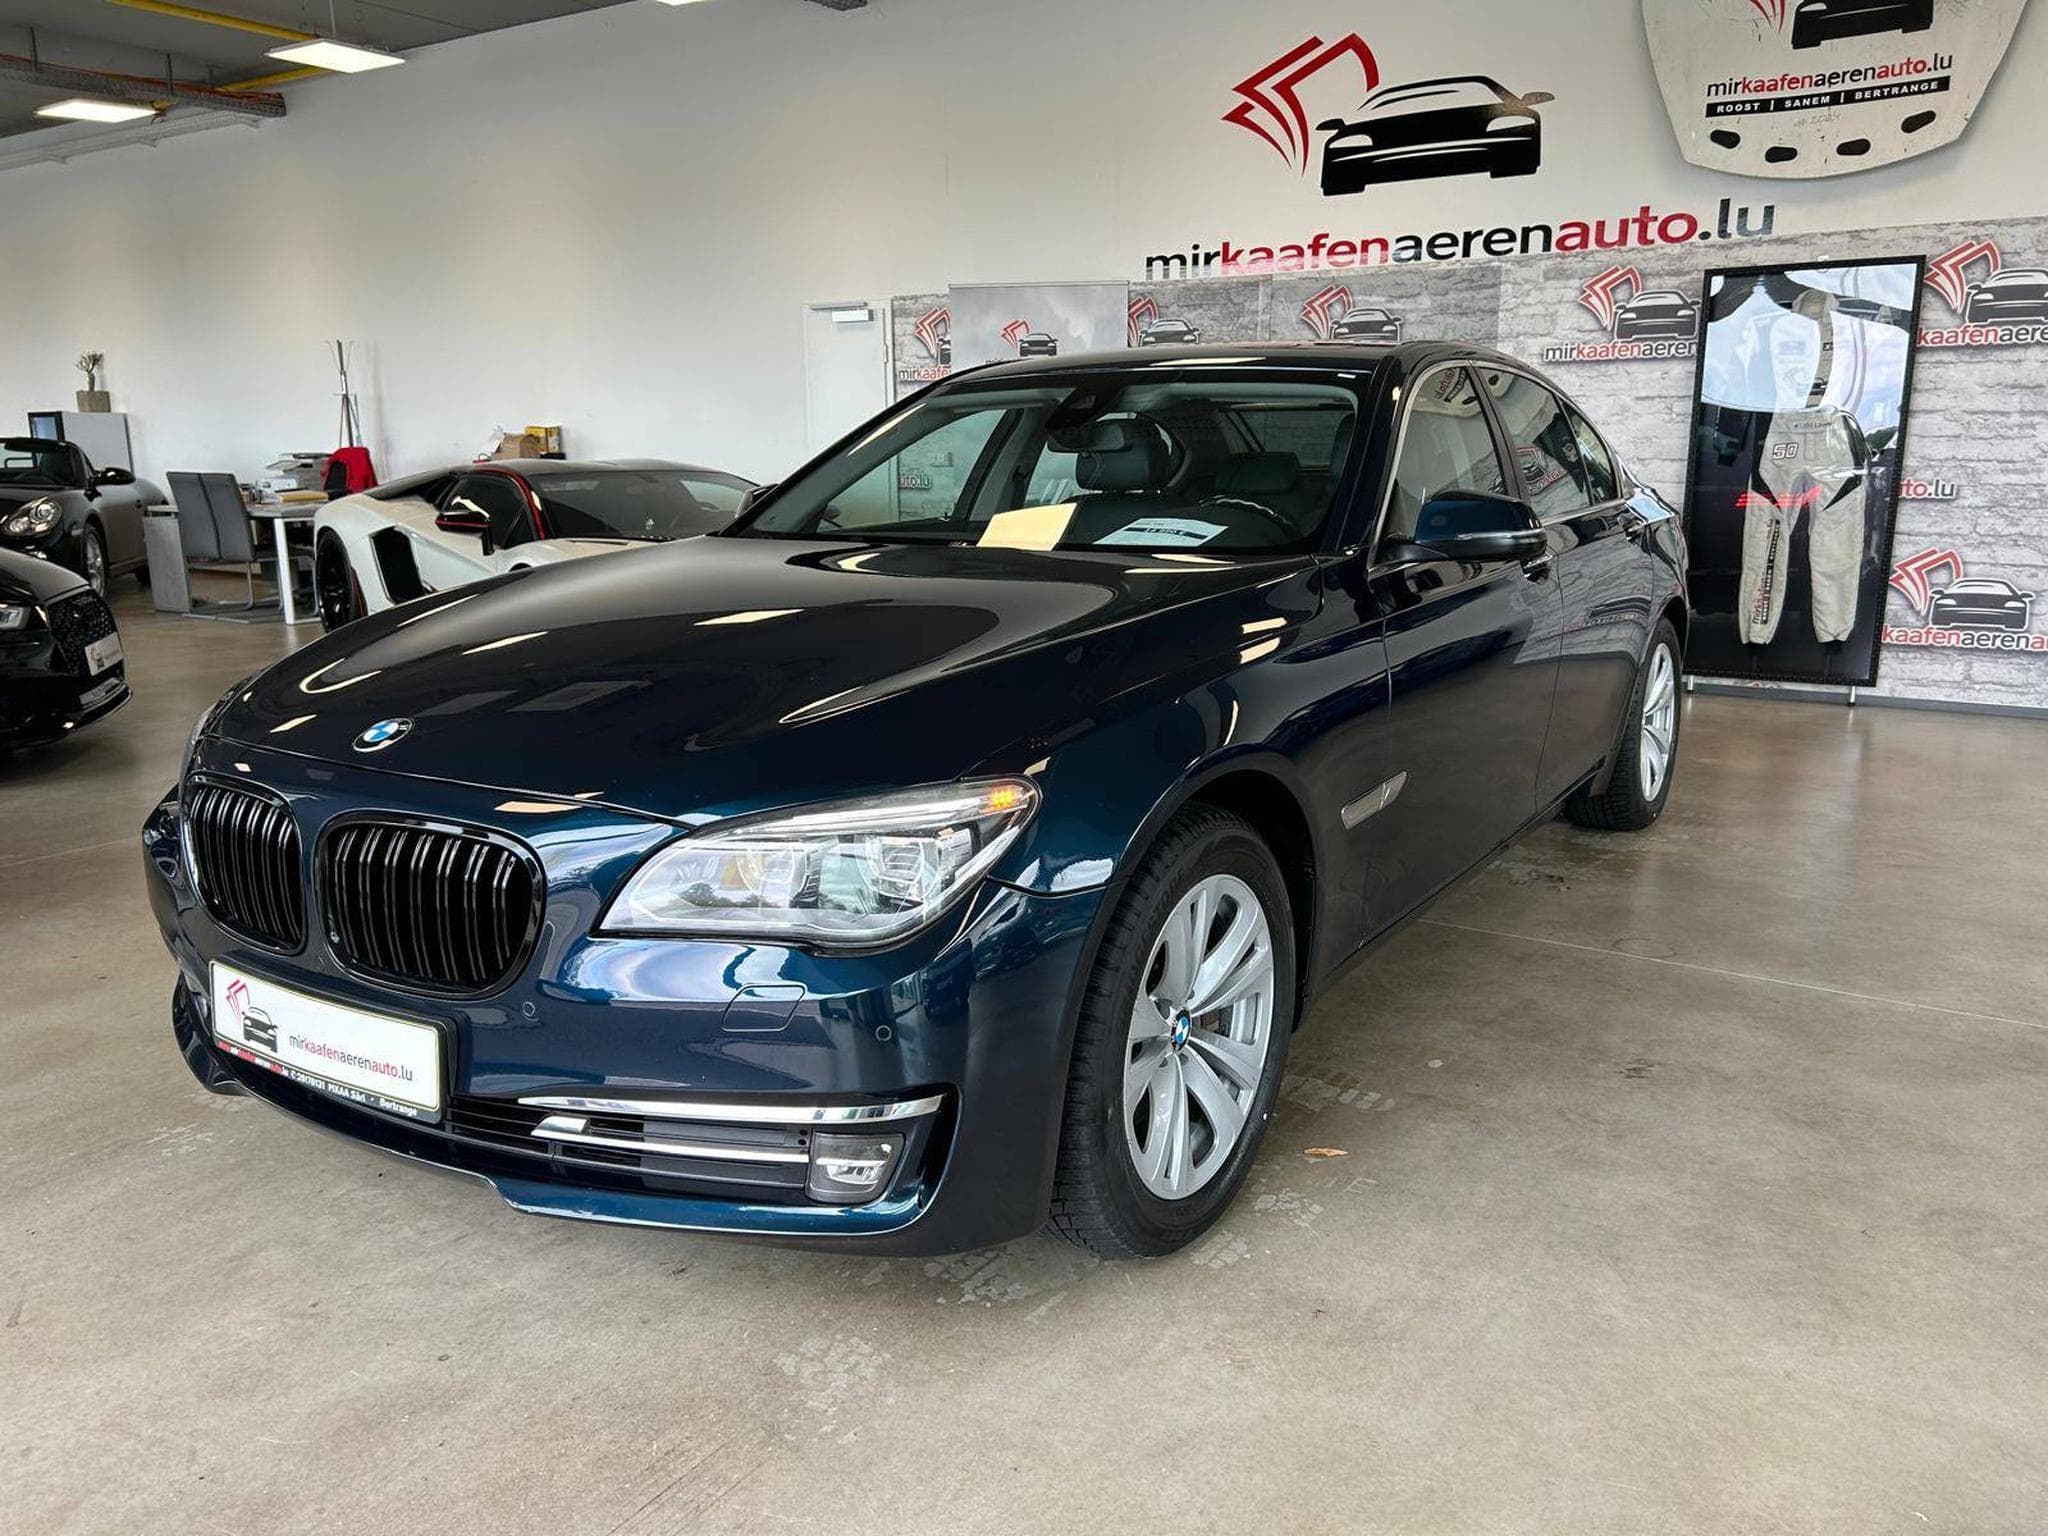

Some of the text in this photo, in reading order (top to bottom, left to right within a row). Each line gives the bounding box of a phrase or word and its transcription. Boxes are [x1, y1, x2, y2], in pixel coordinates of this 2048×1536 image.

[1707, 53, 1953, 97] mirkaafenaerenauto.lu
[1716, 81, 1939, 113] ROOST SANEM BERTRANGE
[1146, 197, 1775, 280] mirkaafenaerenauto.lu
[1772, 442, 1799, 460] 50
[1881, 625, 2048, 650] kaafenaerena
[289, 1035, 413, 1081] mirkaafenaerenauto.lu
